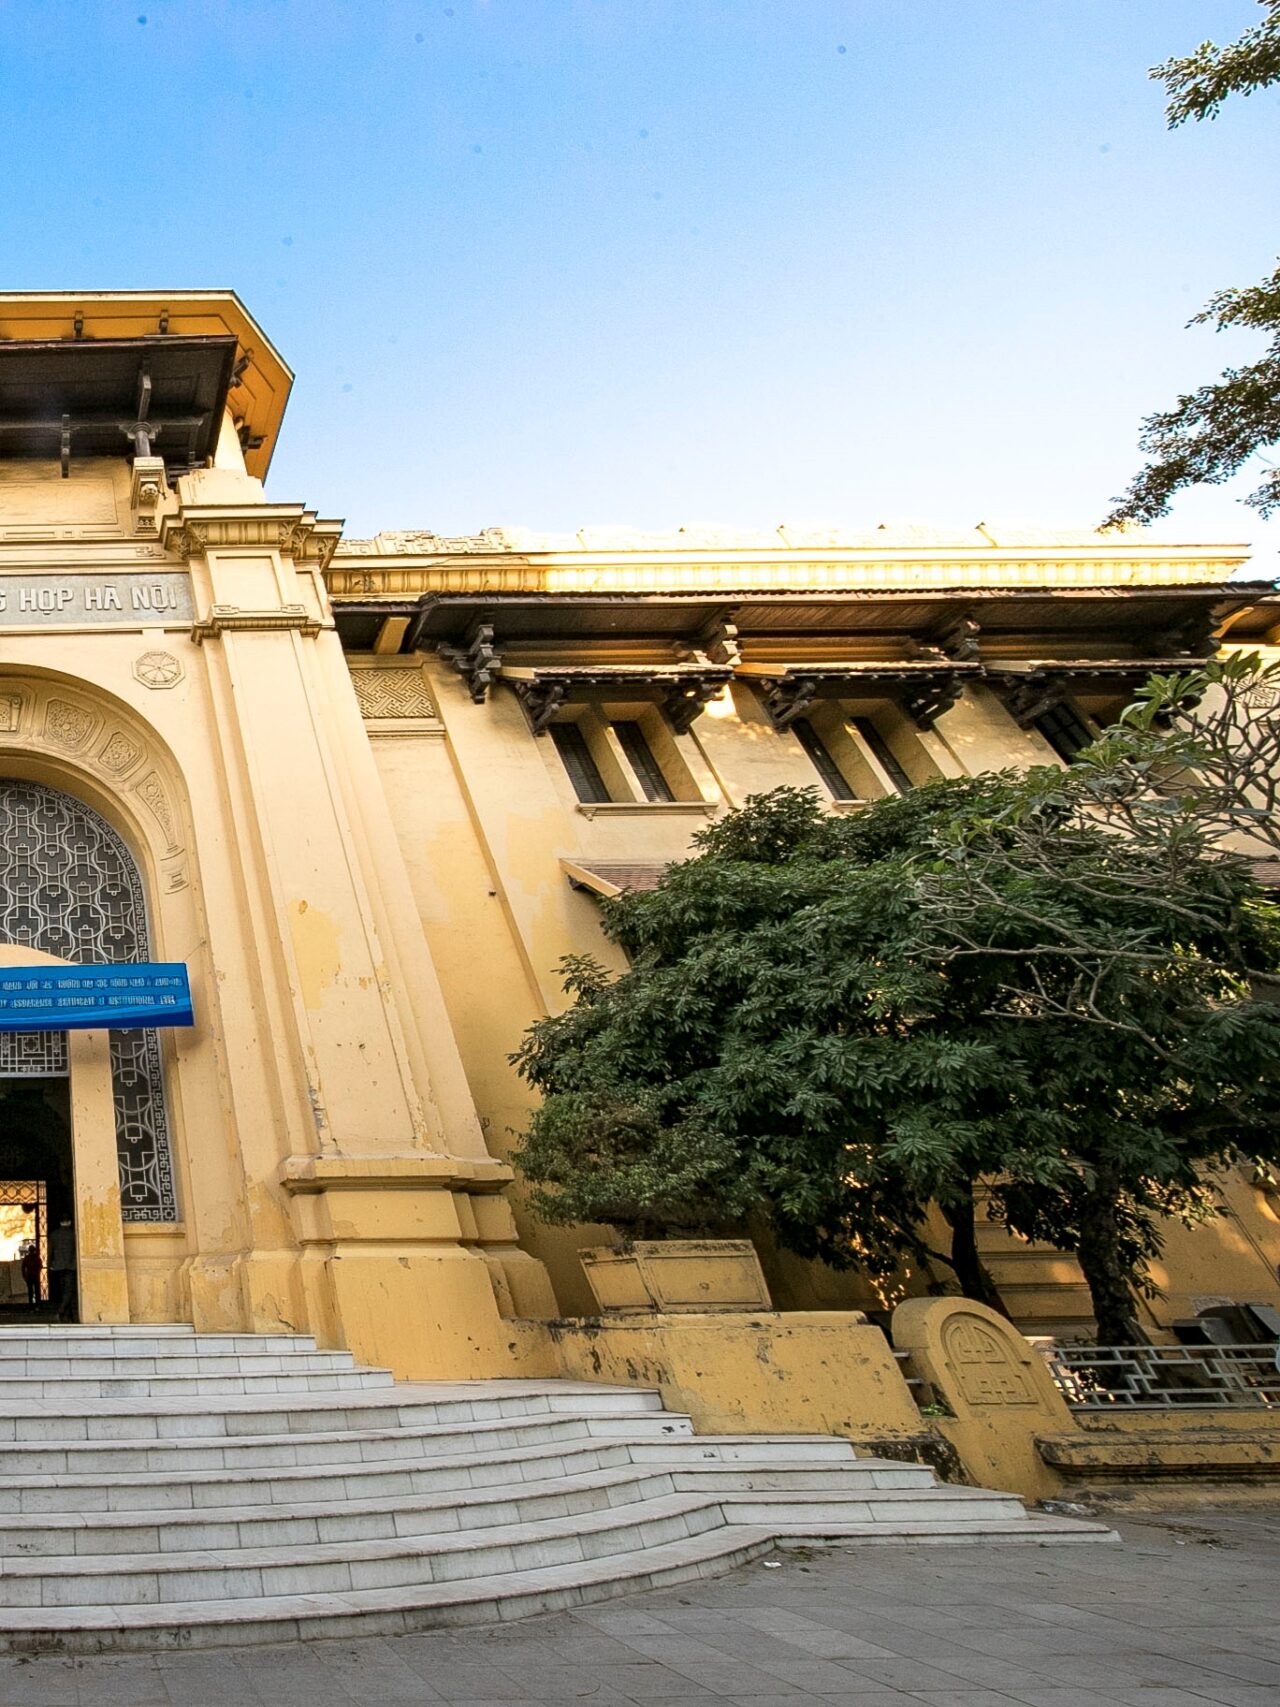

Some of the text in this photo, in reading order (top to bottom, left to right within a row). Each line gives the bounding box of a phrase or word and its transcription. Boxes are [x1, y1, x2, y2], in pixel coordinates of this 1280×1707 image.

[20, 587, 74, 615] HỢP
[84, 584, 123, 610] HÀ
[131, 584, 177, 613] NỘI
